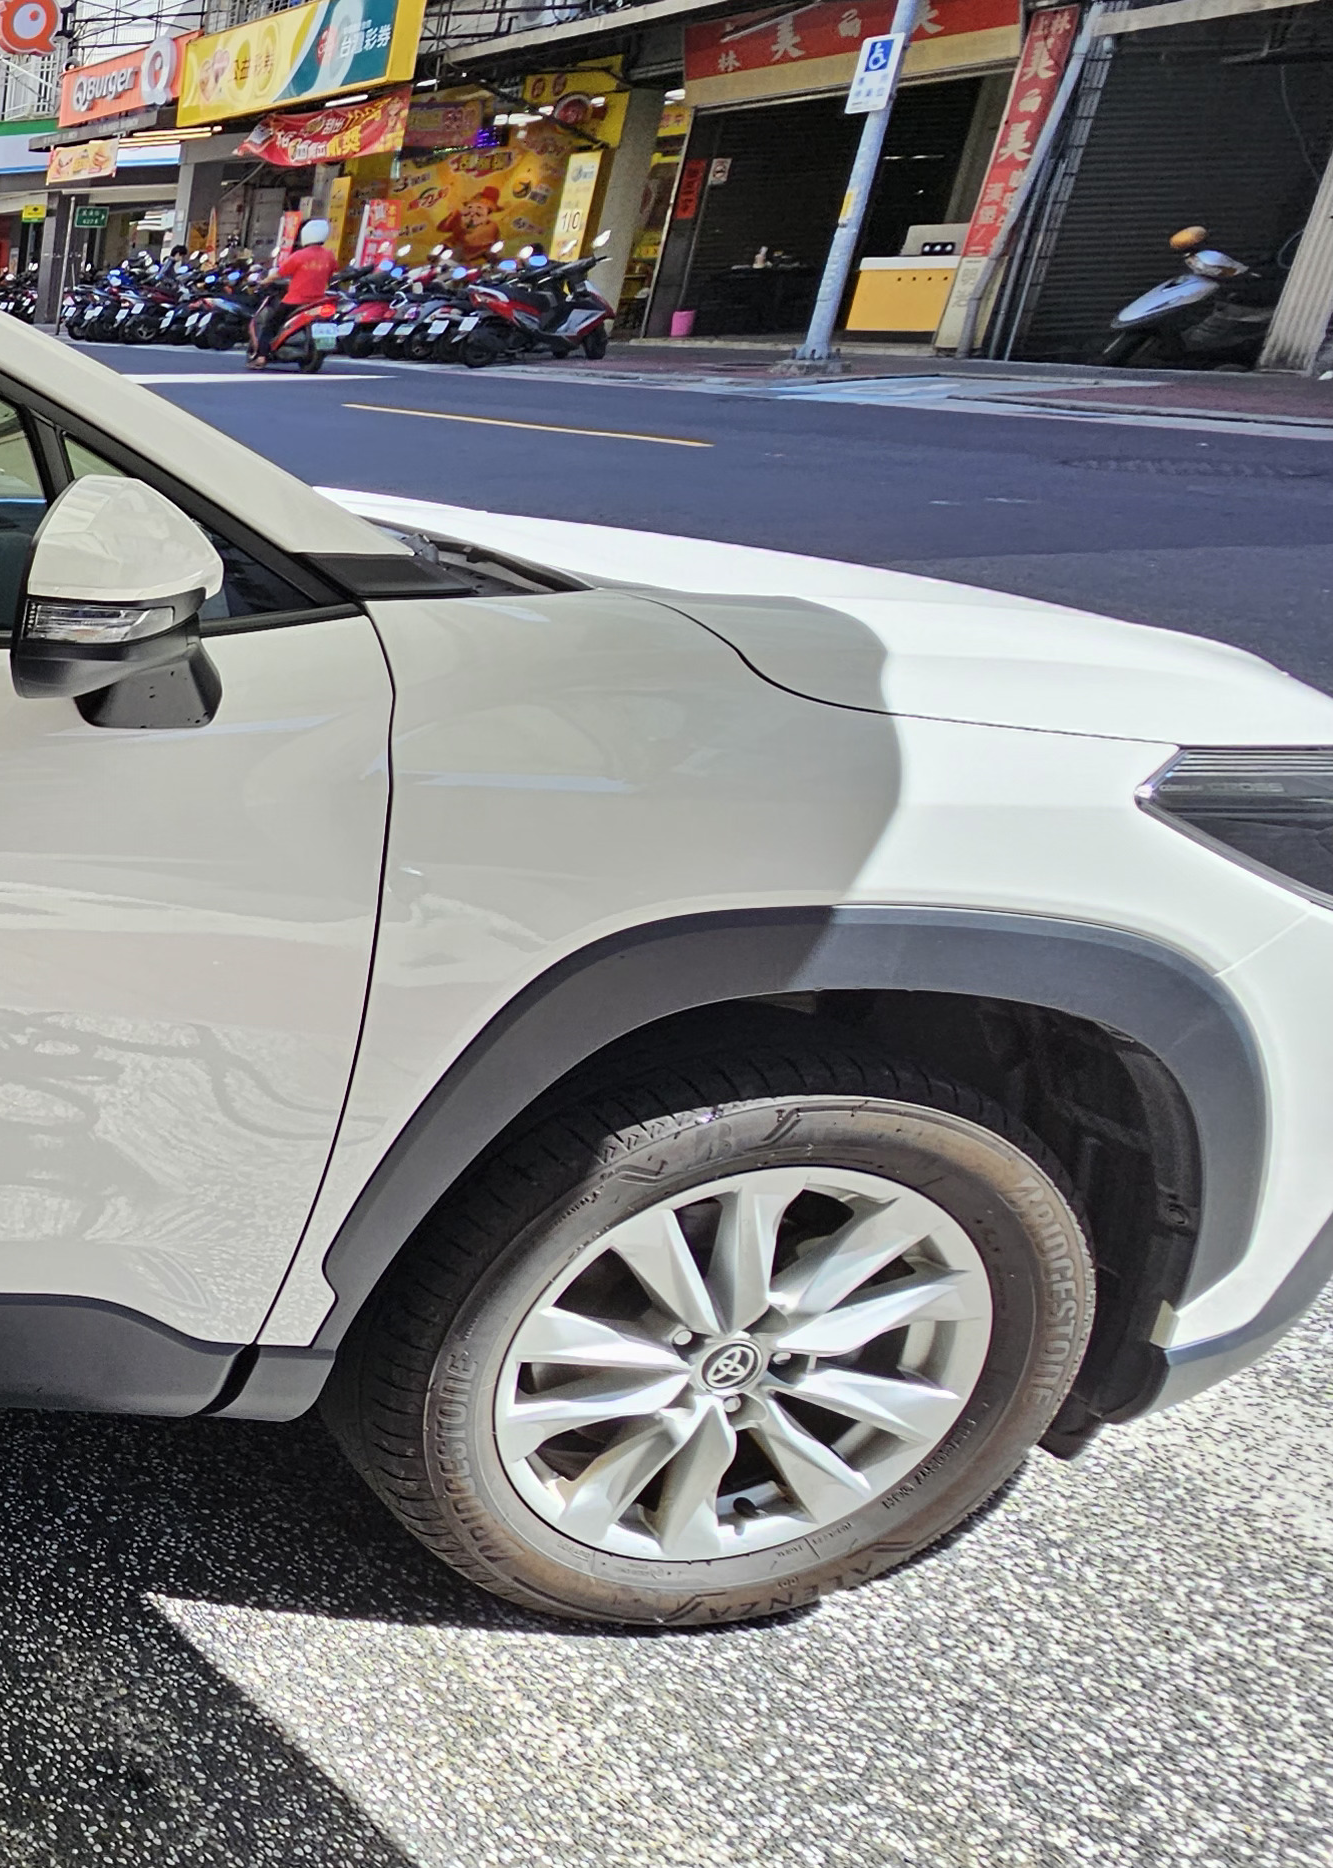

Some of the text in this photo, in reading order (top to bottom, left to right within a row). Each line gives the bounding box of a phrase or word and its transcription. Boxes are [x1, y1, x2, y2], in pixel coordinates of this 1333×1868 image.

[1010, 1175, 1077, 1408] BRIDGESTONE
[434, 1353, 525, 1563] BRIDGESTONE
[708, 1559, 872, 1621] ALENZA
